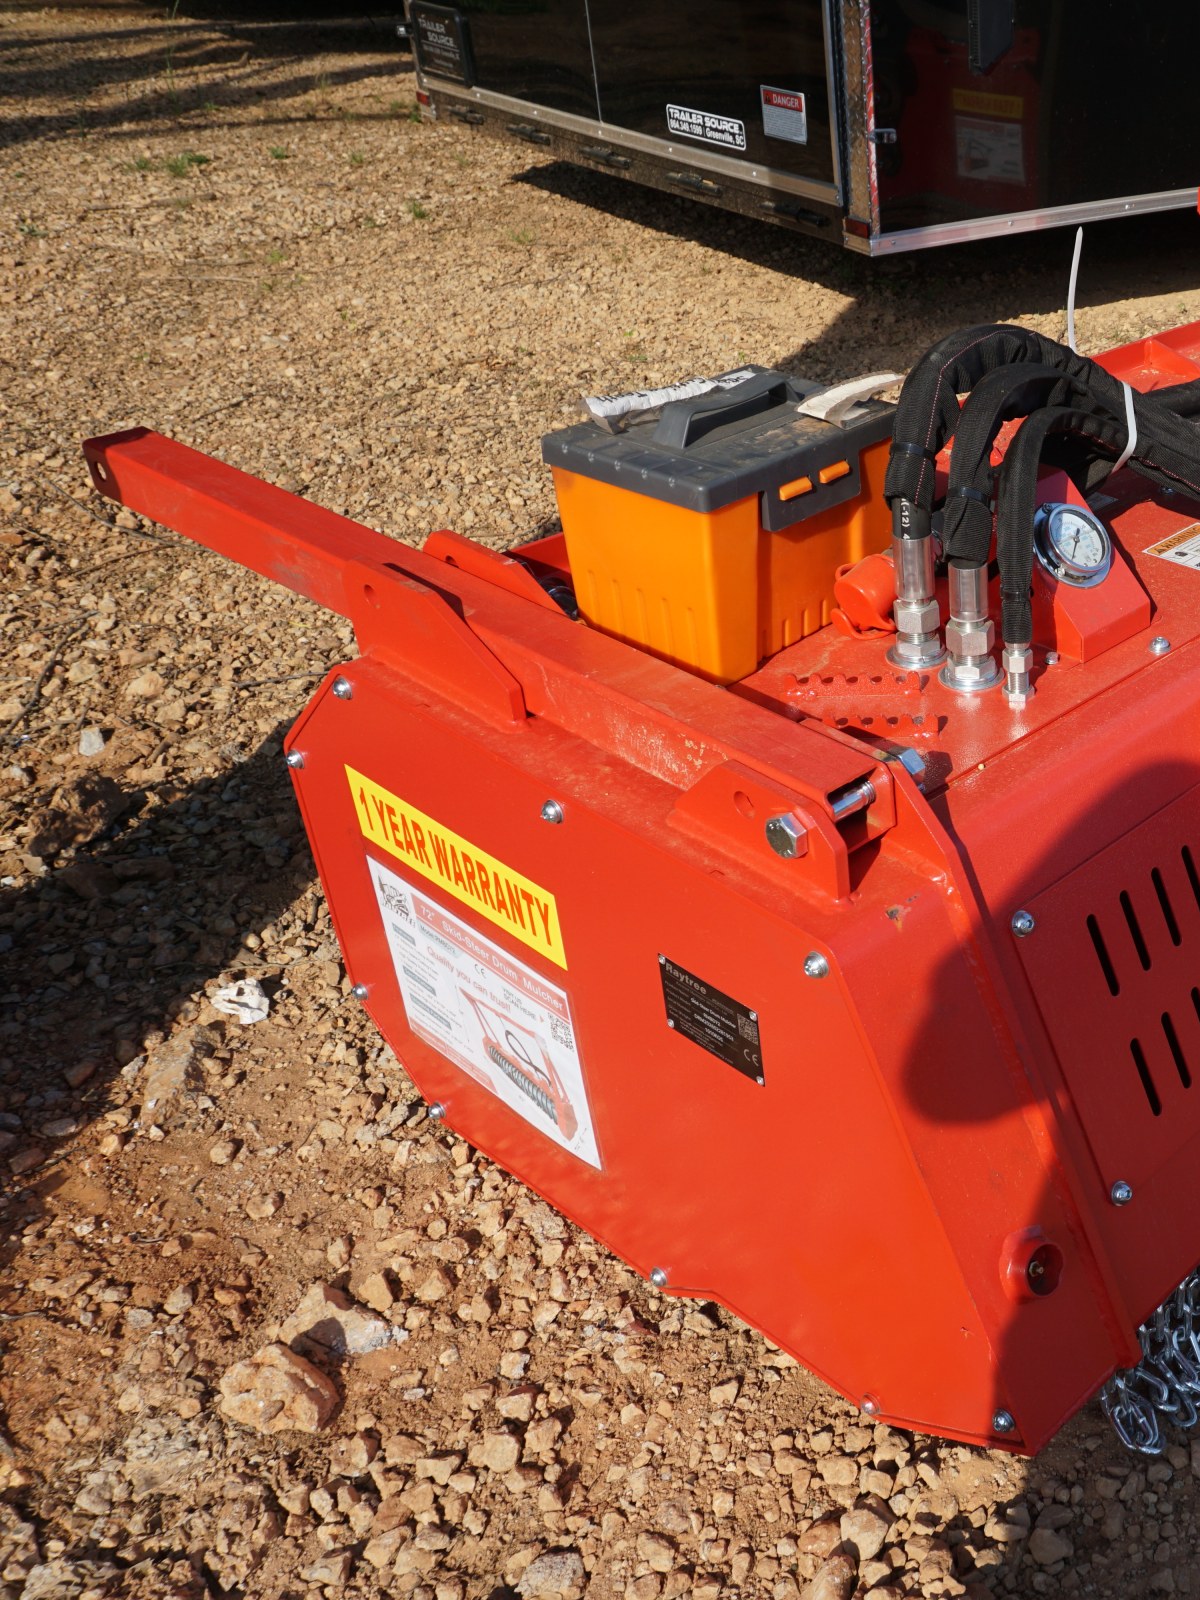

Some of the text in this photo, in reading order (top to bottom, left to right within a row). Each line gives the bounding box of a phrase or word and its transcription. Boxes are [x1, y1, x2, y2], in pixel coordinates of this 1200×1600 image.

[772, 93, 800, 109] DANGER
[669, 108, 740, 133] TRAILER SOURCE
[735, 135, 744, 146] SC
[359, 787, 552, 947] 1 YEAR WARRANTY
[427, 945, 455, 973] Quality
[456, 967, 471, 984] you
[472, 981, 489, 997] can
[441, 920, 490, 961] Skid-Steer
[492, 955, 519, 981] Drum
[522, 977, 564, 1010] Mulcher
[665, 962, 707, 995] Raytree
